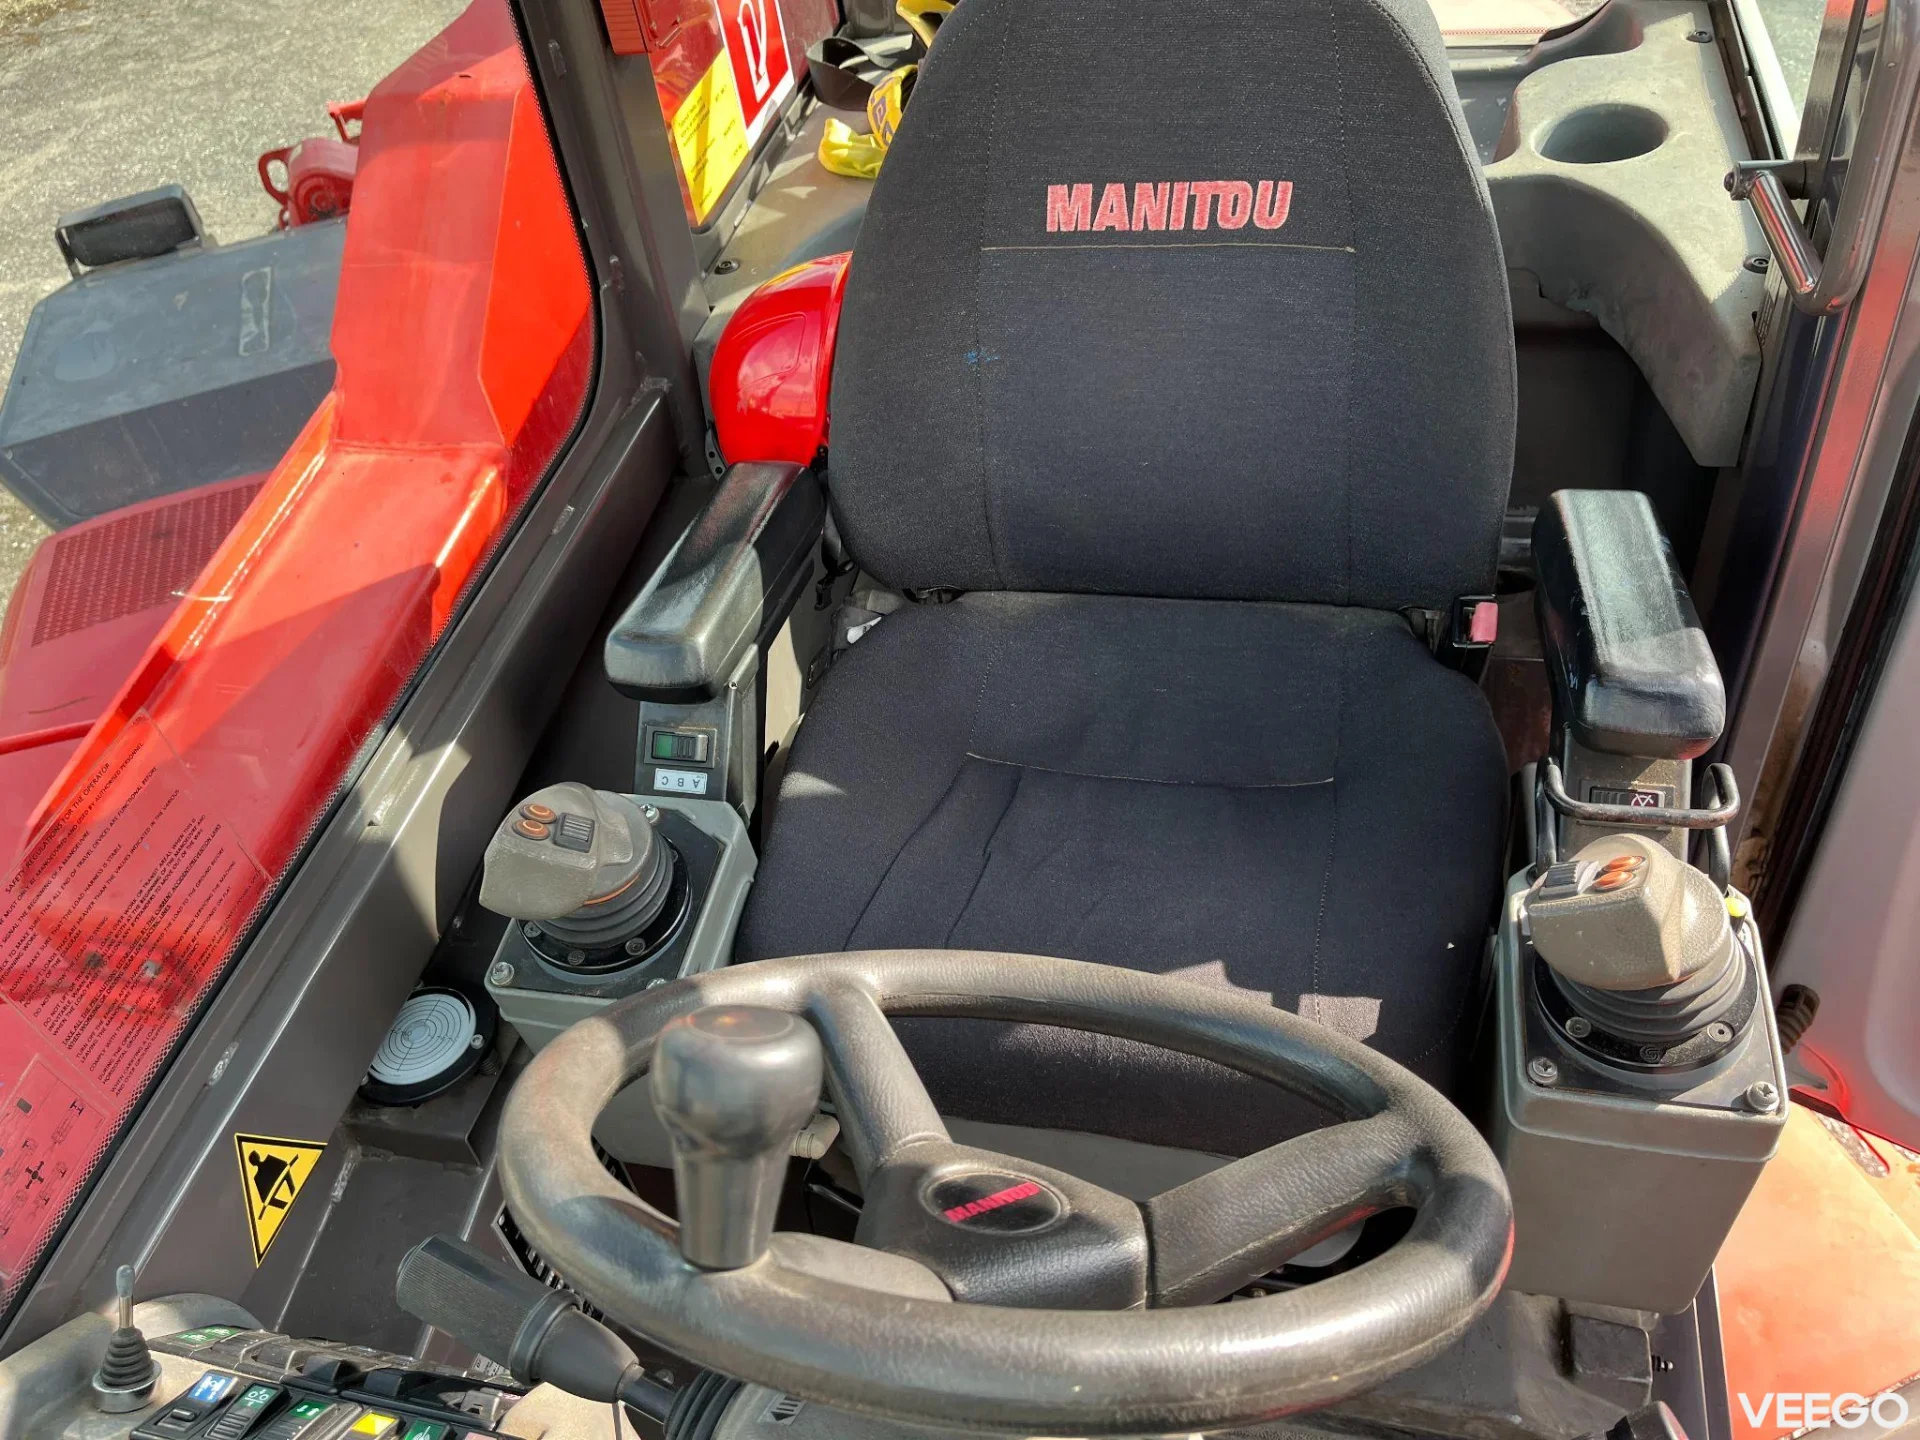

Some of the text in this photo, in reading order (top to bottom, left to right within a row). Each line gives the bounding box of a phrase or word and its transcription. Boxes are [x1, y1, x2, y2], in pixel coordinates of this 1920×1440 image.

[1046, 180, 1293, 232] MANITOU
[661, 775, 700, 788] A B C
[6, 762, 110, 894] SAFETY REGULATIONS FOR THE OPERATOR
[4, 900, 18, 918] MUST
[17, 885, 30, 901] ONLY
[36, 837, 68, 877] MANOEUVRED
[67, 824, 78, 838] AND
[16, 932, 30, 949] MAKE
[29, 917, 41, 932] SURE
[41, 900, 53, 916] THAT
[53, 890, 61, 901] ALL
[61, 877, 71, 890] END
[78, 849, 93, 868] TRAVEL
[28, 879, 52, 911] BEGINNING
[9, 969, 28, 993] ALWAYS
[27, 951, 41, 969] MAKE
[41, 937, 52, 951] SURE
[52, 920, 64, 936] THAT
[64, 909, 73, 920] THE
[72, 892, 85, 909] LOAD
[84, 868, 103, 892] HARNESS
[19, 983, 34, 1003] NEVER
[42, 952, 57, 972] LOADS
[57, 936, 69, 952] THAT
[68, 925, 77, 937] ARE
[77, 901, 95, 925] HEAVIER
[95, 885, 107, 901] THAN
[107, 874, 116, 884] THE
[51, 1003, 61, 1017] NOT
[60, 991, 69, 1003] LIFT
[99, 930, 113, 950] LOADS
[113, 915, 125, 930] OVER
[124, 898, 137, 915] WORK
[144, 868, 159, 889] TRANSIT
[173, 833, 185, 850] WHEN
[53, 1017, 67, 1036] WHEN
[67, 1006, 76, 1018] THE
[75, 989, 87, 1006] LOAD
[107, 939, 122, 960] ALLOW
[122, 927, 131, 940] ANY
[161, 870, 173, 886] MOVE
[173, 858, 182, 870] OUT
[187, 840, 195, 851] THE
[72, 979, 86, 998] WARN
[115, 922, 127, 939] BOTH
[132, 904, 141, 915] THE
[167, 857, 175, 867] THE
[41, 994, 51, 1007] NOT
[51, 973, 67, 994] ALLOW
[67, 961, 75, 973] THE
[75, 944, 88, 961] LOAD
[53, 957, 61, 969] THE
[76, 1042, 88, 1059] TURN
[87, 1031, 96, 1043] OFF
[104, 998, 118, 1019] ENGINE
[119, 980, 131, 998] AFTER
[172, 905, 184, 922] LOAD
[189, 887, 197, 898] THE
[196, 865, 213, 888] GROUND
[62, 1029, 75, 1046] TAKE
[74, 1019, 82, 1030] ALL
[81, 1007, 90, 1019] THE
[68, 1031, 81, 1050] WHEN
[123, 955, 135, 971] NEAR
[134, 942, 144, 956] LIVE
[80, 1038, 98, 1063] LEAVING
[98, 1027, 106, 1038] THE
[89, 1048, 107, 1072] COMPLY
[106, 1032, 117, 1048] WITH
[117, 1021, 125, 1032] THE
[98, 1058, 114, 1081] DURING
[114, 1046, 122, 1058] THE
[122, 1015, 144, 1046] OPERATING
[103, 1048, 128, 1085] HORIZONTAL
[127, 1023, 145, 1049] GROUND
[111, 1073, 124, 1093] WHEN
[115, 1083, 125, 1097] AND
[124, 1067, 136, 1083] OVER
